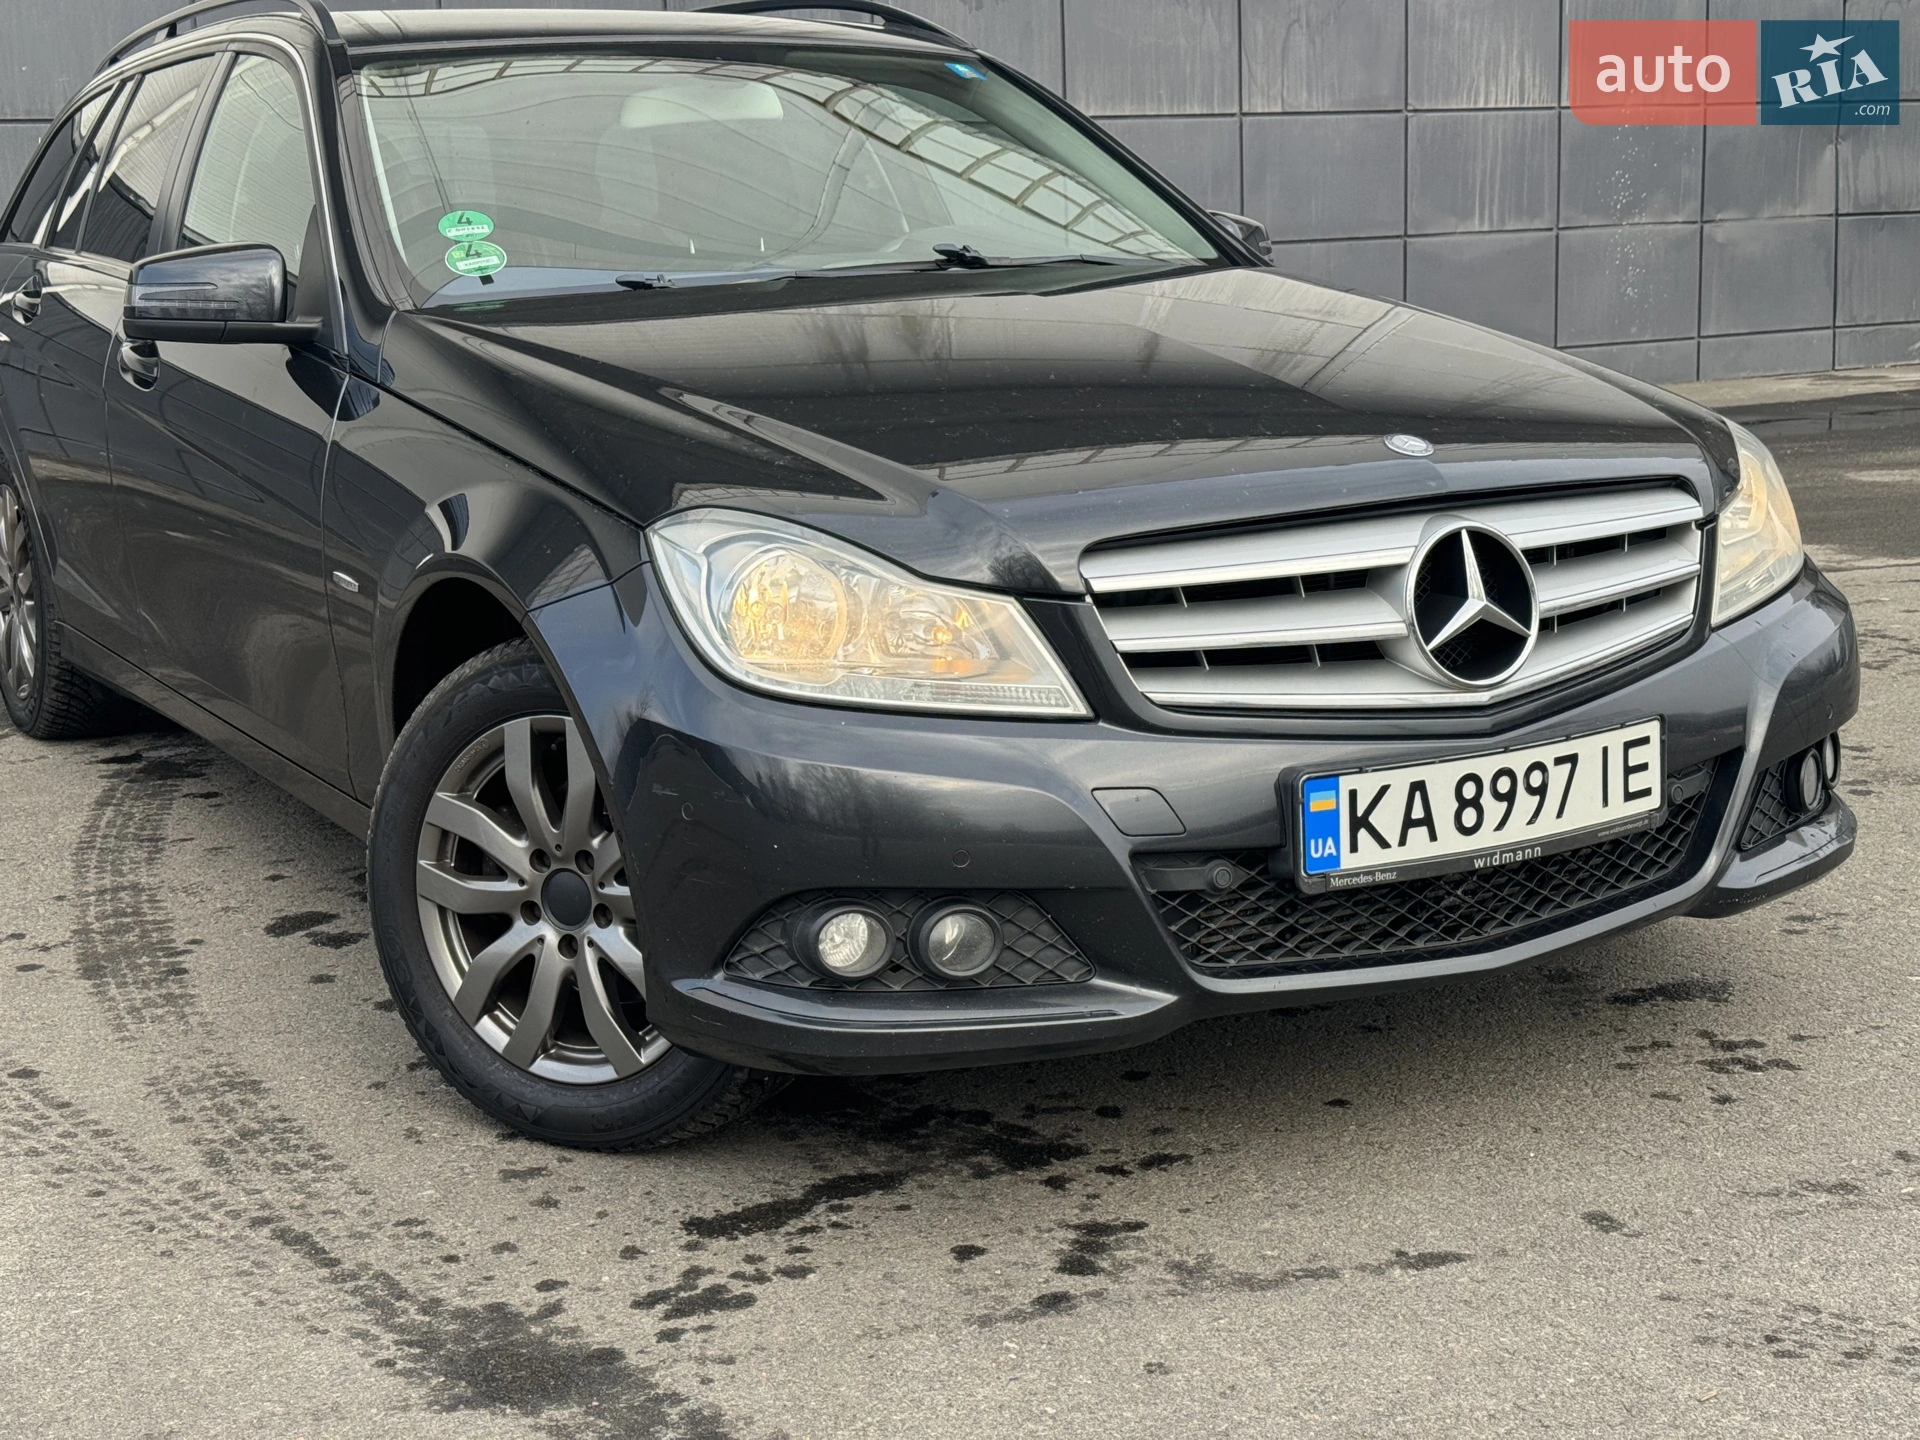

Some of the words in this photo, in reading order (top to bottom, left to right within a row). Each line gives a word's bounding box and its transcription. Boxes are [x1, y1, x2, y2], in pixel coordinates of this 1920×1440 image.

[457, 211, 473, 226] 4
[466, 244, 482, 258] 4
[1348, 779, 1439, 854] KA
[1453, 753, 1580, 837] 8997
[1601, 735, 1653, 809] IE
[1310, 836, 1337, 859] UA
[1474, 844, 1542, 870] widmann
[1329, 870, 1397, 888] Mercedes-Benz
